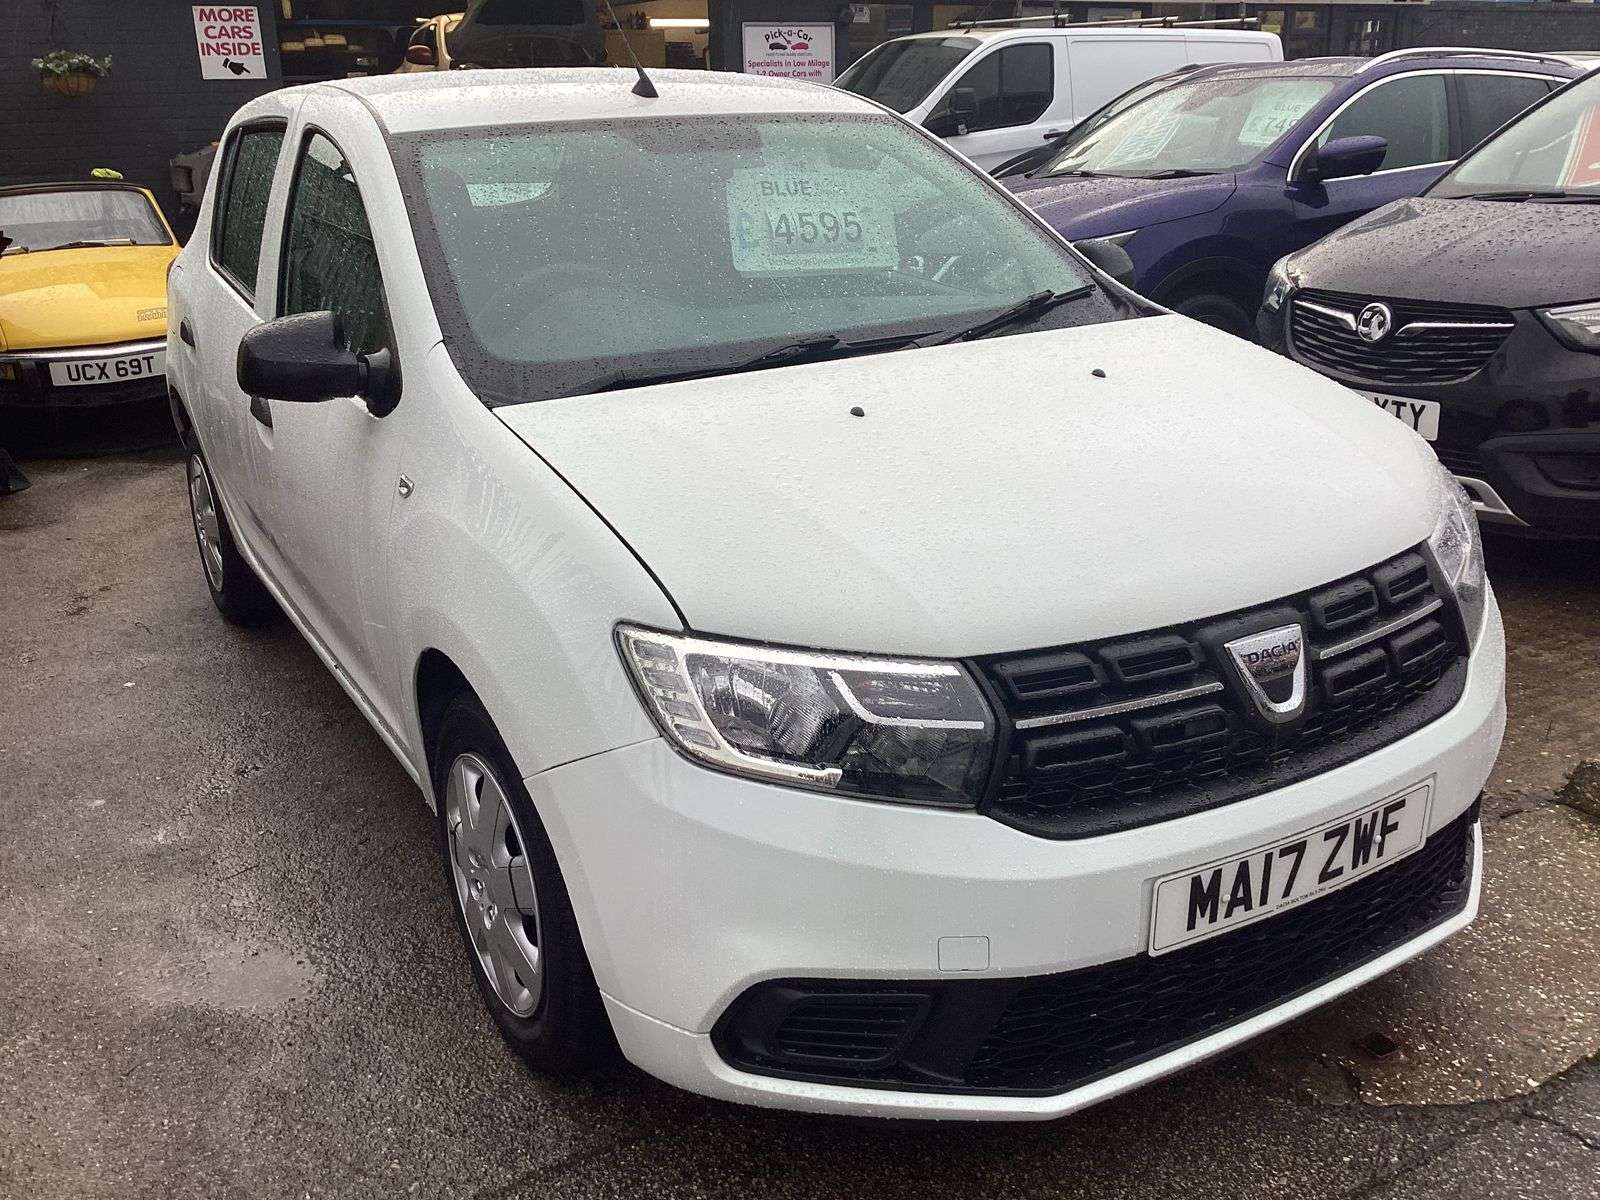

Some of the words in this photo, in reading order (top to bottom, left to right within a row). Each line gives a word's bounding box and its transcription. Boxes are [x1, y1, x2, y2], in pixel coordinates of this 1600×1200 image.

[199, 8, 255, 22] MORE
[204, 25, 254, 39] CARS
[200, 42, 262, 56] INSIDE
[747, 59, 783, 68] Specialists
[793, 59, 807, 67] Low
[808, 59, 830, 68] Milage
[808, 69, 822, 77] with
[760, 180, 812, 197] BLUE
[66, 361, 110, 381] UCX
[115, 355, 154, 378] 69T
[1247, 641, 1298, 663] DACIA
[1187, 839, 1307, 932] MA17
[1318, 798, 1407, 885] ZWF
